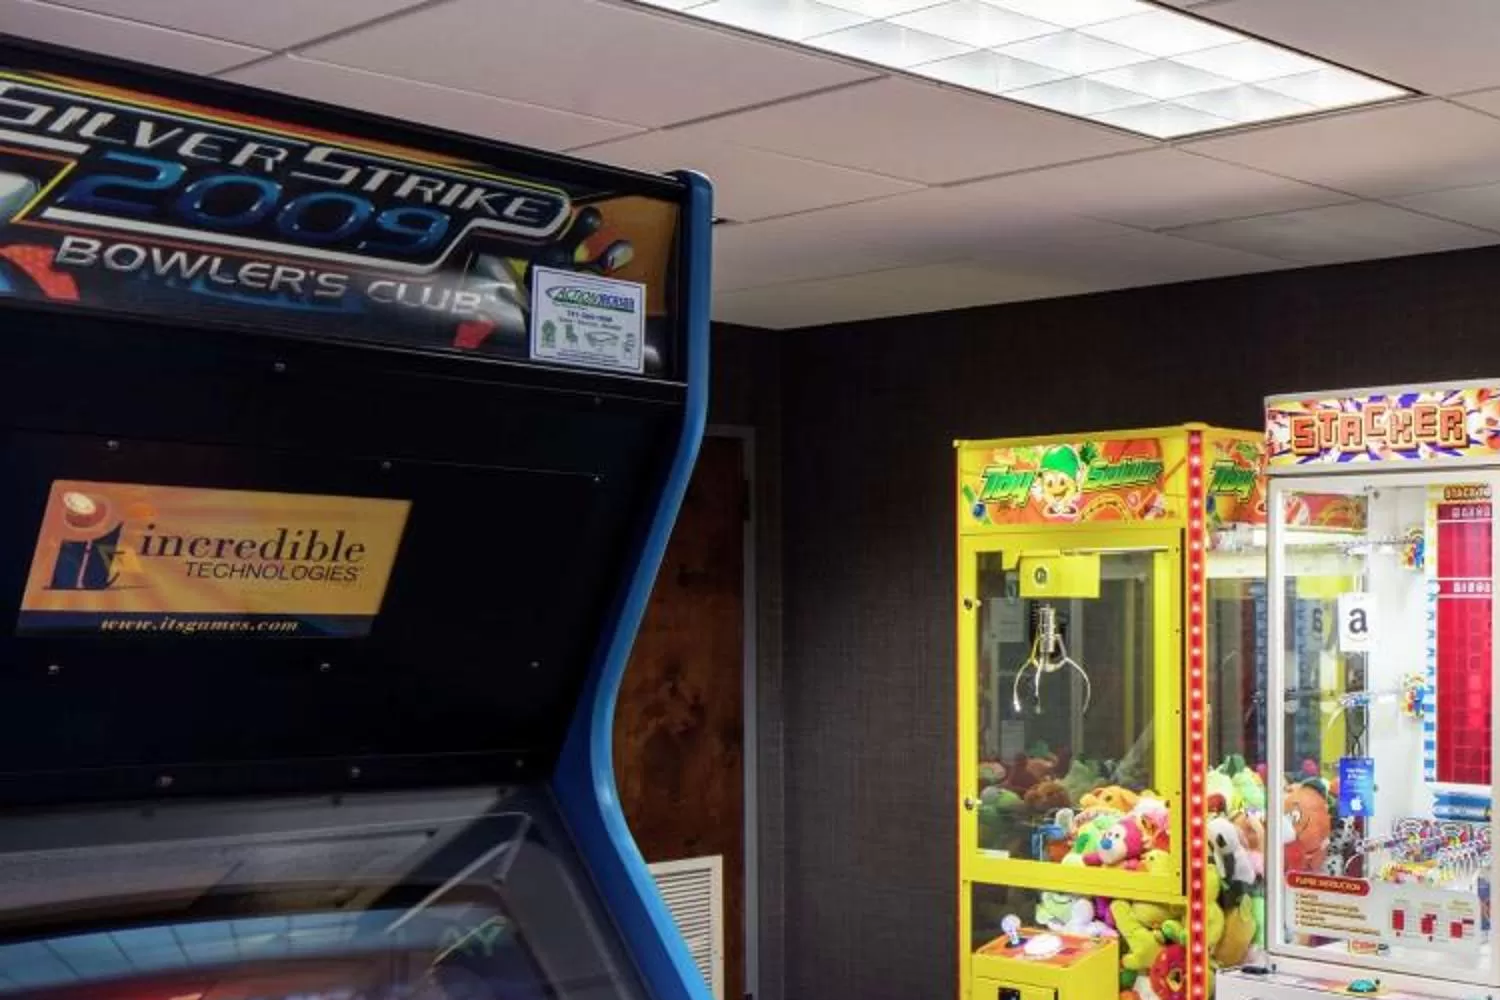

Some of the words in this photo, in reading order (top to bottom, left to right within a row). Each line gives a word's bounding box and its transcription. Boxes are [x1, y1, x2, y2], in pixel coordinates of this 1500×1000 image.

[56, 151, 454, 254] 2009
[291, 144, 549, 223] STRIKE
[55, 235, 349, 298] BOWLER'S
[367, 278, 484, 315] CLUB
[1291, 402, 1468, 456] STACKER
[141, 523, 366, 563] incredible
[185, 561, 360, 582] TECHNOLOGIES
